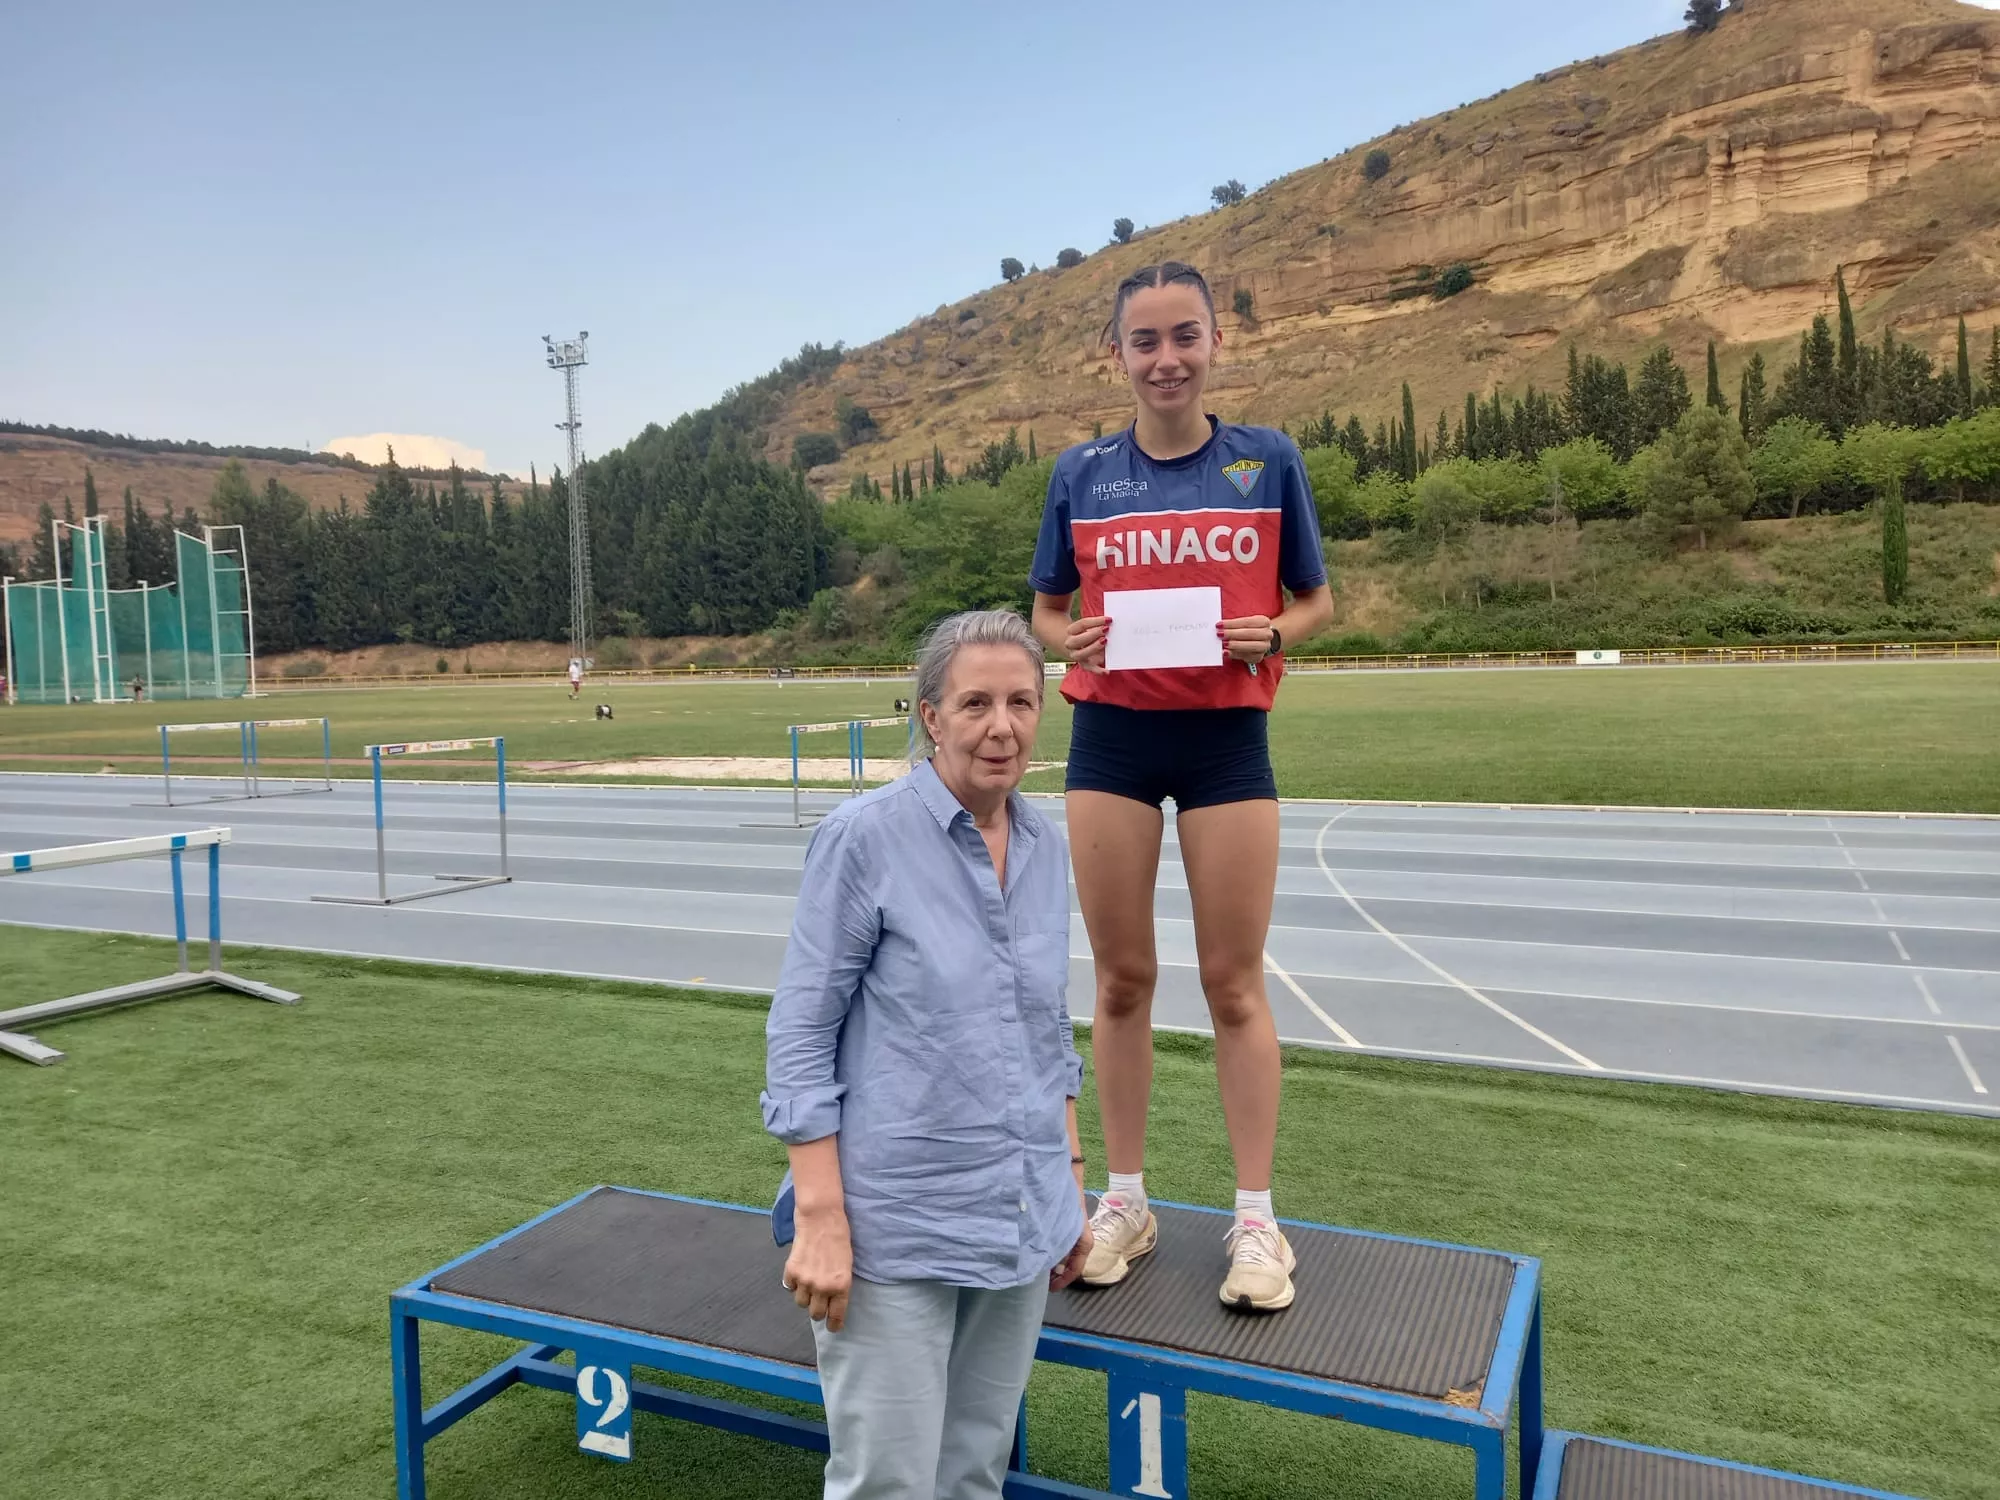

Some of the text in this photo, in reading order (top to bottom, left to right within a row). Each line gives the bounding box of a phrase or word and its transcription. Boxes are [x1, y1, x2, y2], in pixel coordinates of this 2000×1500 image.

[1096, 525, 1259, 569] HINACO
[577, 1366, 630, 1458] 2
[1121, 1392, 1172, 1499] 1
